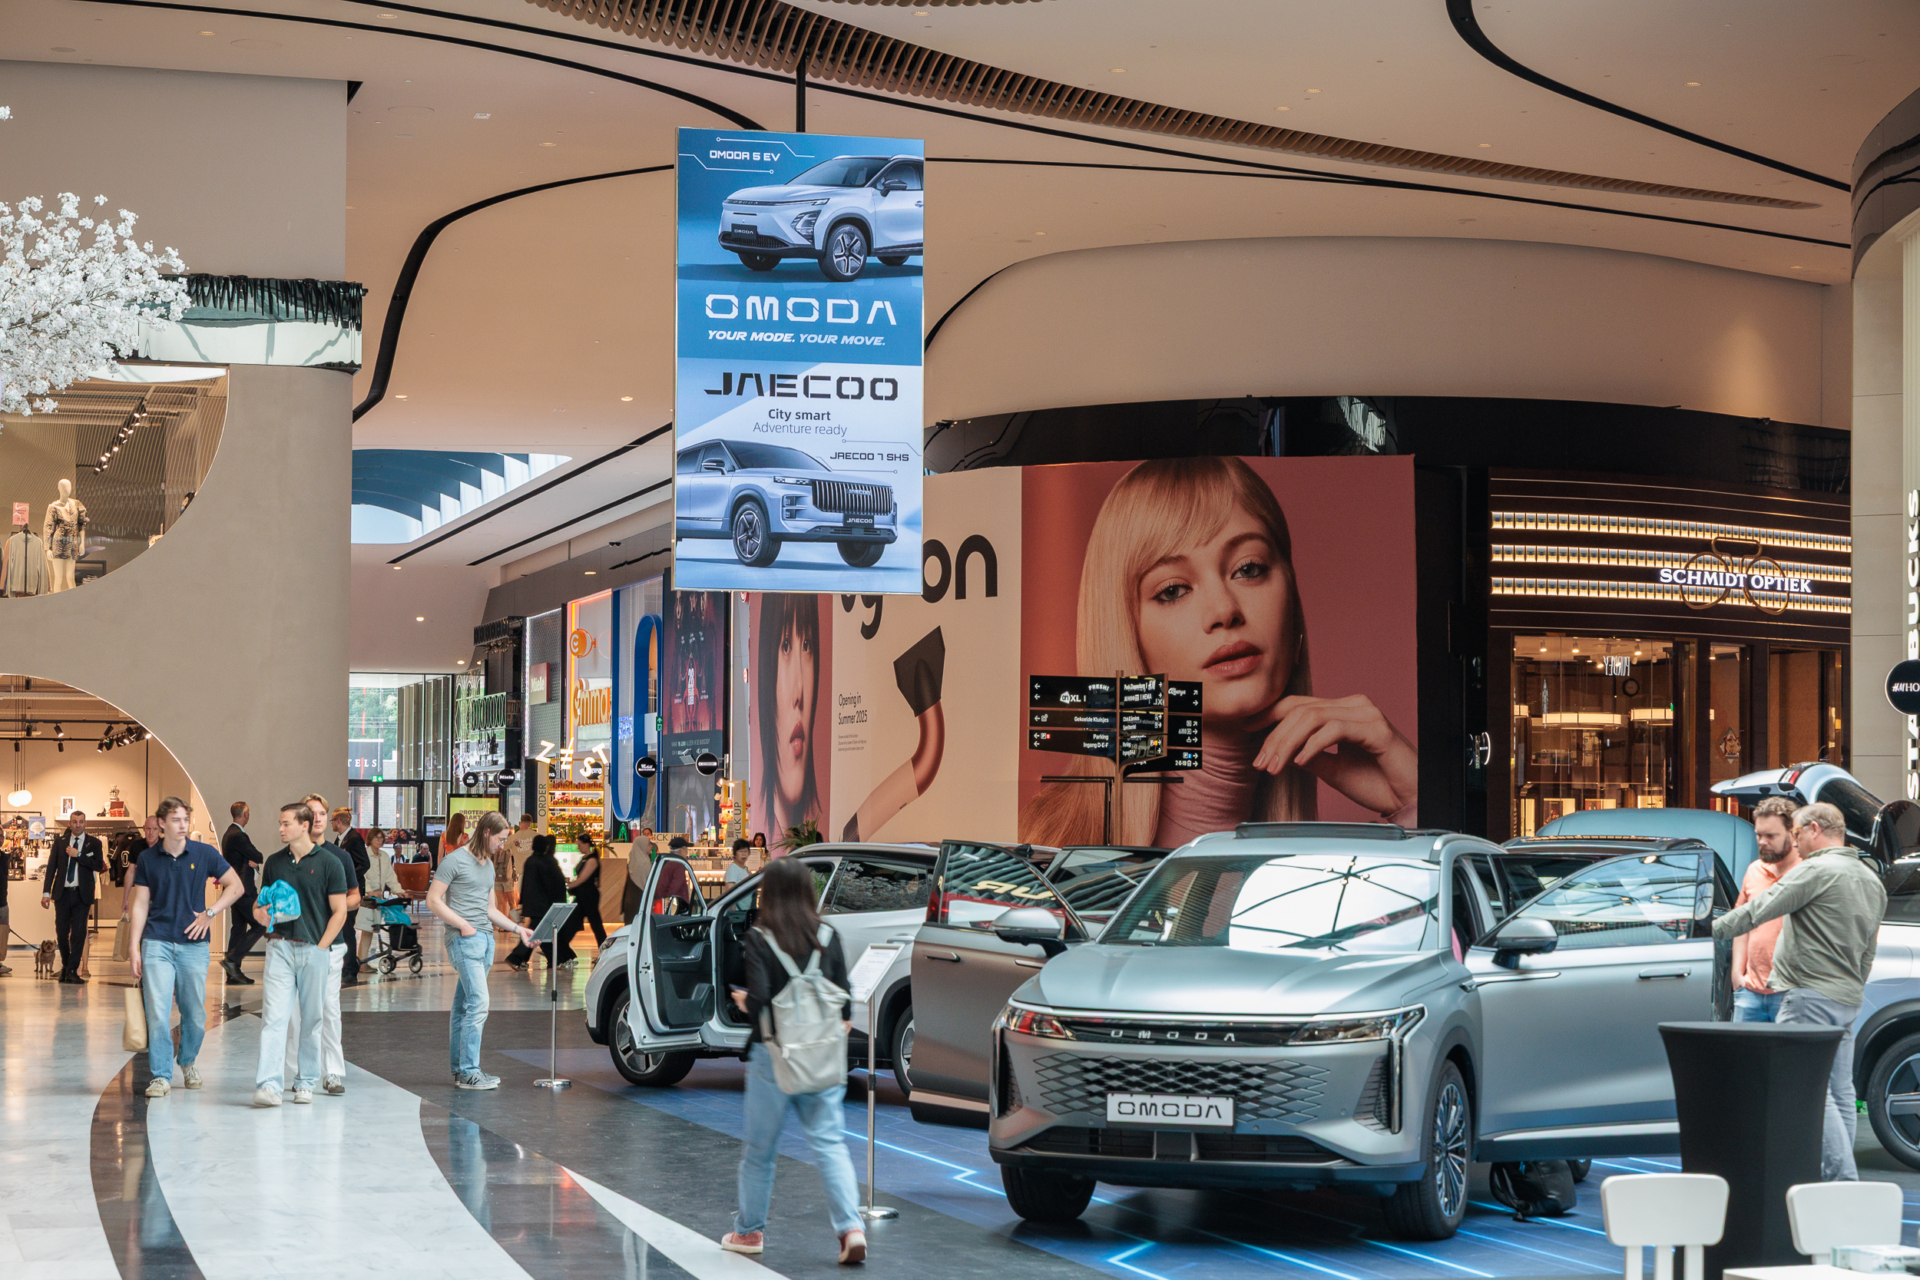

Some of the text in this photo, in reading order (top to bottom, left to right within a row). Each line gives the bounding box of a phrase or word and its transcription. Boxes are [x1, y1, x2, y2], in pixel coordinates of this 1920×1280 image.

[709, 150, 781, 162] OMODA 5 EV
[705, 294, 897, 325] OMODA
[707, 330, 886, 346] YOUR MODE. YOUR MOVE.
[704, 372, 899, 401] JAECOO
[768, 408, 831, 422] City smart
[753, 422, 848, 437] Adventure ready
[830, 452, 910, 462] JAECOO 7 SHS
[1659, 568, 1812, 593] SCHMIDT OPTIEK
[1908, 489, 1920, 800] STABUCKS
[838, 692, 862, 708] Opening in
[1070, 694, 1082, 702] XL
[838, 710, 868, 725] Summer 2025
[538, 783, 547, 817] ORDER
[734, 801, 742, 816] UP
[1110, 1030, 1236, 1042] OMODA
[1117, 1101, 1222, 1119] OMODA
